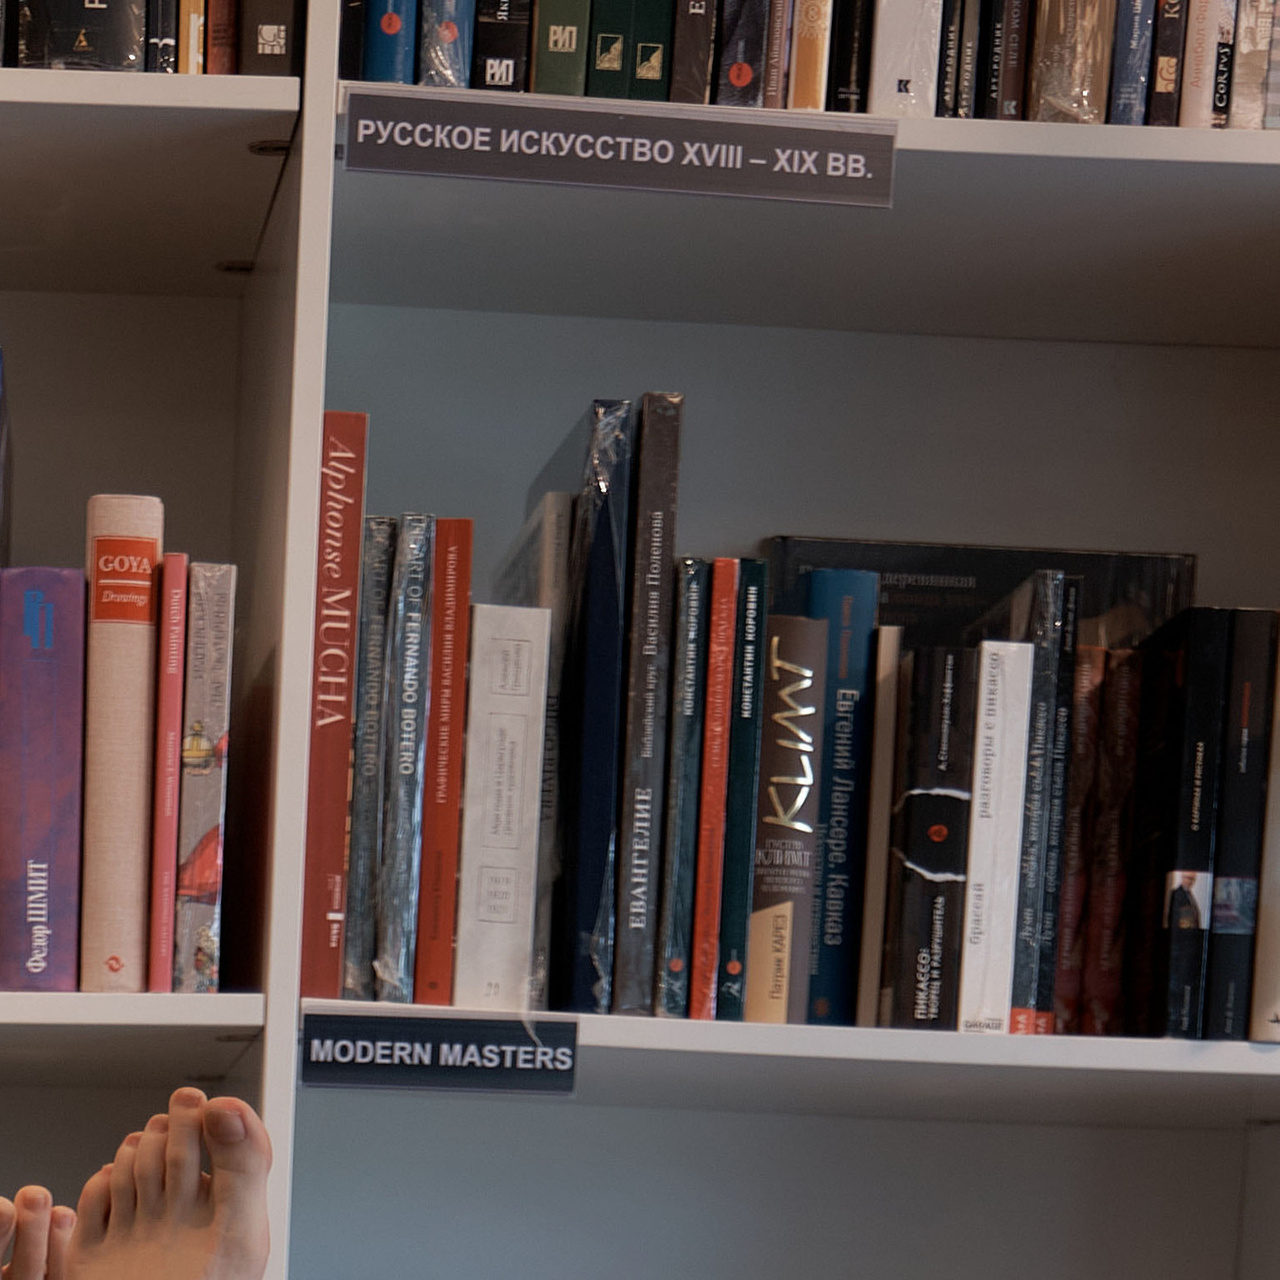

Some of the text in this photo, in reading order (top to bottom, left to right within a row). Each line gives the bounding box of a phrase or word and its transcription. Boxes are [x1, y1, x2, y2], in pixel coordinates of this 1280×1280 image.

[357, 119, 491, 151] РУССКОЕ
[499, 129, 674, 162] ИСКУССТВО
[682, 141, 743, 168] XVIII
[773, 150, 818, 174] XIX
[827, 153, 873, 178] ВВ.
[99, 555, 152, 574] GOYA
[316, 435, 358, 730] Alphonse MUCHA
[644, 509, 664, 586] Поленова
[165, 588, 184, 674] Dutch Painting
[435, 545, 459, 804] ГРАФИЧЕСКИЕ МИРЫ ВАСИЛИЯ ВЛАДИМИРОВА
[642, 590, 661, 656] Василия
[682, 583, 700, 716] КОНСТАНТИН КОРОВИН
[740, 584, 759, 718] КОНСТАНТИН КОРОВИН
[361, 609, 386, 777] FERNANDO BOTERO
[398, 611, 422, 776] FERNANDO BOTERO
[761, 635, 816, 833] KLIMT
[628, 787, 654, 929] ЕВАНГЕЛИЕ
[823, 688, 861, 946] Евгений Лансере. Кавказ
[24, 860, 51, 974] Федор ШМИТ
[913, 948, 932, 1020] ПИКАССО:
[310, 1039, 573, 1070] MODERN MASTERS
